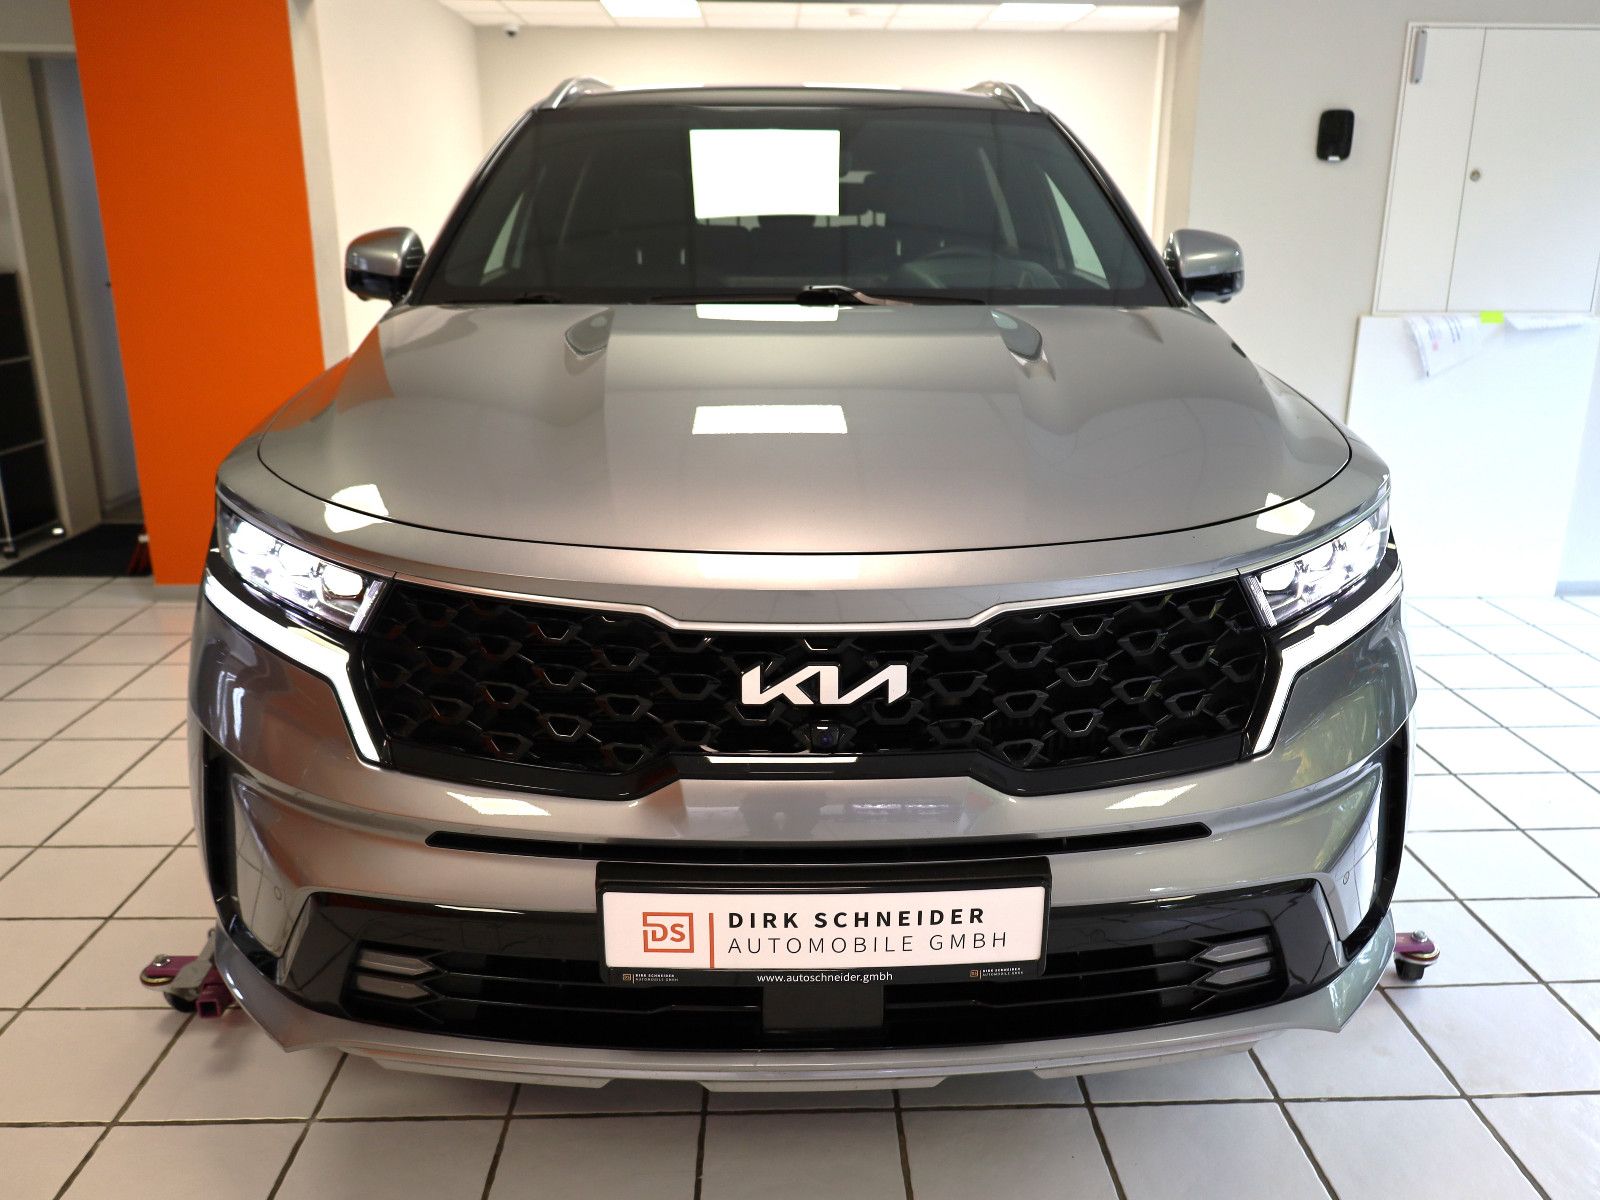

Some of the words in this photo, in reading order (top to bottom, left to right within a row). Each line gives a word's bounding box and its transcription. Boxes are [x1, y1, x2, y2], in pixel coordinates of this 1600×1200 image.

[741, 664, 908, 705] KIA
[728, 912, 799, 929] DIRK
[814, 908, 984, 929] SCHNEIDER
[727, 935, 914, 954] AUTOMOBILE
[929, 931, 1006, 951] GMBH
[756, 971, 893, 984] www.autoschneider.gmbh
